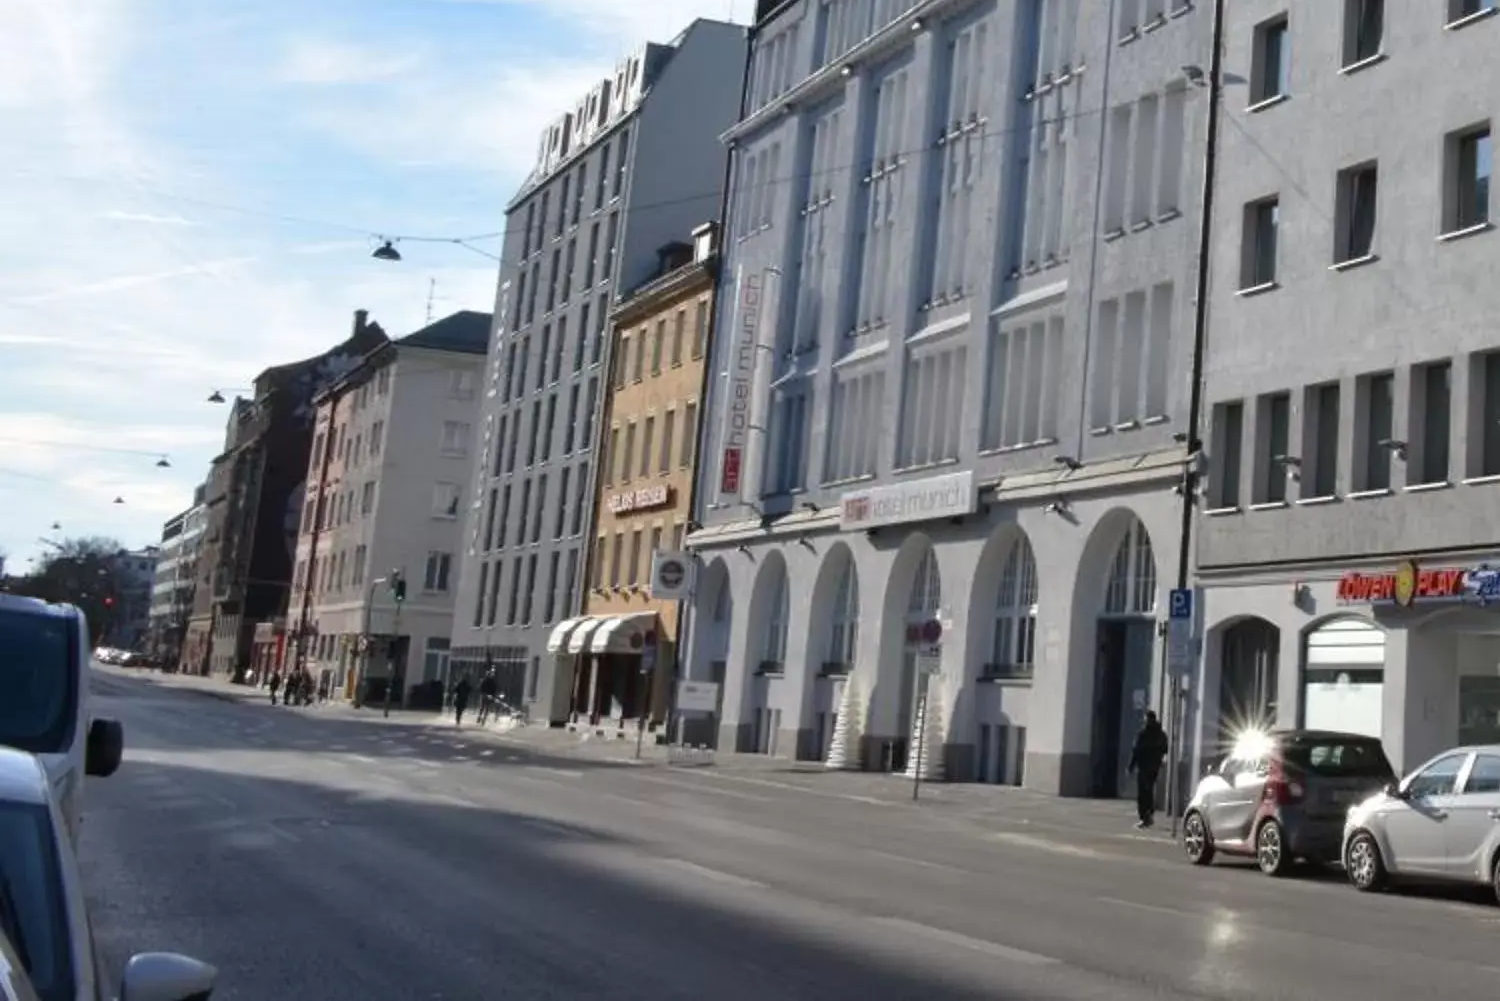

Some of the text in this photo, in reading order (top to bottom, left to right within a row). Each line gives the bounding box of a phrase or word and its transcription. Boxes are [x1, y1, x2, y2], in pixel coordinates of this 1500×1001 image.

[738, 274, 760, 370] munich
[1416, 569, 1465, 597] PLAY
[1171, 592, 1186, 616] P
